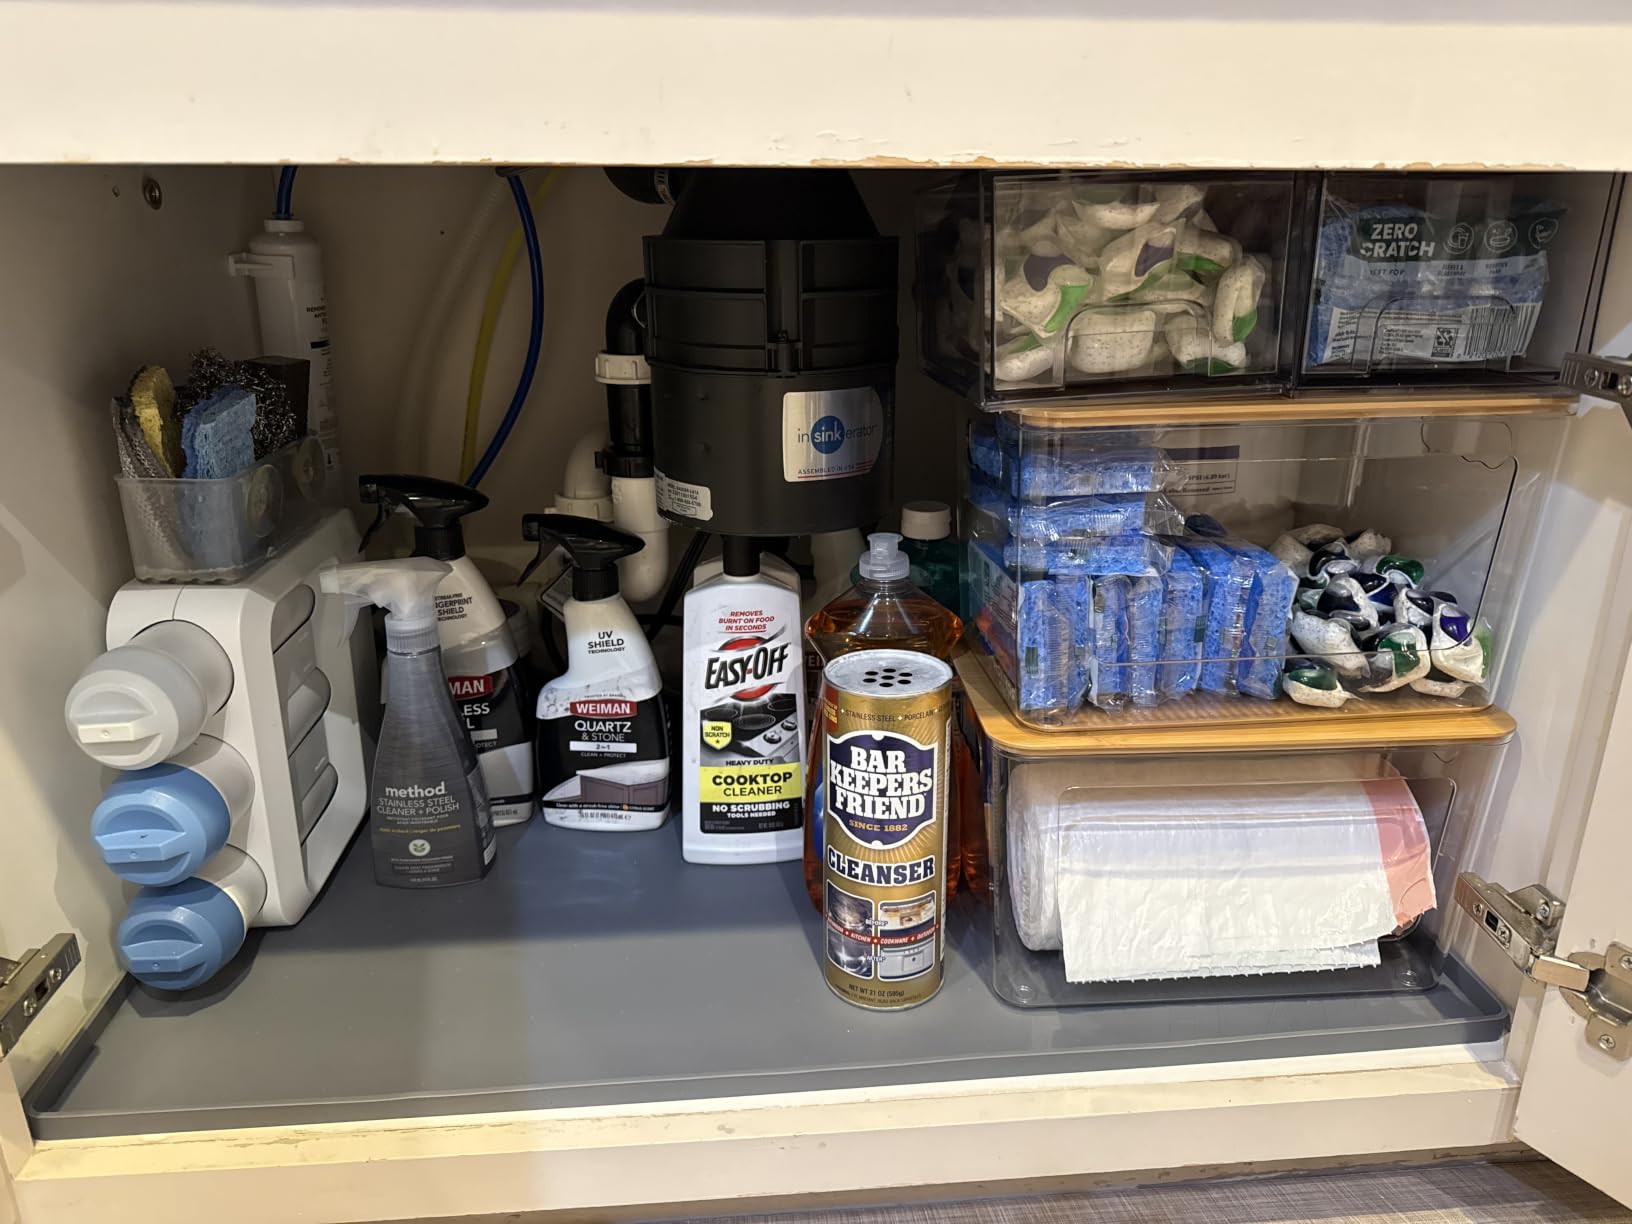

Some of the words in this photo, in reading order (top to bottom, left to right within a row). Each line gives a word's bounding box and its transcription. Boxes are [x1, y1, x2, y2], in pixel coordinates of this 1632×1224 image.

[1371, 223, 1418, 240] ZERO
[798, 466, 835, 474] ASSEMBLED
[438, 606, 464, 616] SHIELD
[598, 630, 613, 640] UV
[588, 638, 624, 649] SHIELD
[588, 646, 626, 654] TECHNOLOGY
[704, 642, 792, 690] EASY-OFF
[464, 702, 490, 716] ESS
[576, 703, 630, 714] WEIMAN
[845, 709, 876, 721] STAINLESS
[904, 710, 934, 721] PORCELAIN
[574, 720, 632, 732] QUARTZ
[582, 733, 590, 741] &
[592, 733, 625, 742] STONE
[850, 746, 906, 774] BAR
[712, 772, 793, 786] COOKTOP
[830, 760, 932, 796] KEEPERS
[385, 781, 446, 798] method
[723, 786, 782, 797] CLEANER
[379, 798, 424, 808] STAINLESS
[427, 796, 456, 806] STEEL
[712, 804, 728, 812] NO
[730, 801, 790, 812] SCRUBBING
[835, 786, 926, 820] FRIEND
[376, 806, 416, 816] CLEANER
[426, 802, 460, 814] POLISH
[848, 820, 880, 831] SINCE
[884, 824, 908, 832] 1882
[828, 846, 935, 885] CLEANSER
[850, 932, 871, 943] KITCHEN
[880, 936, 909, 944] COOKWARE
[848, 984, 858, 992] NET
